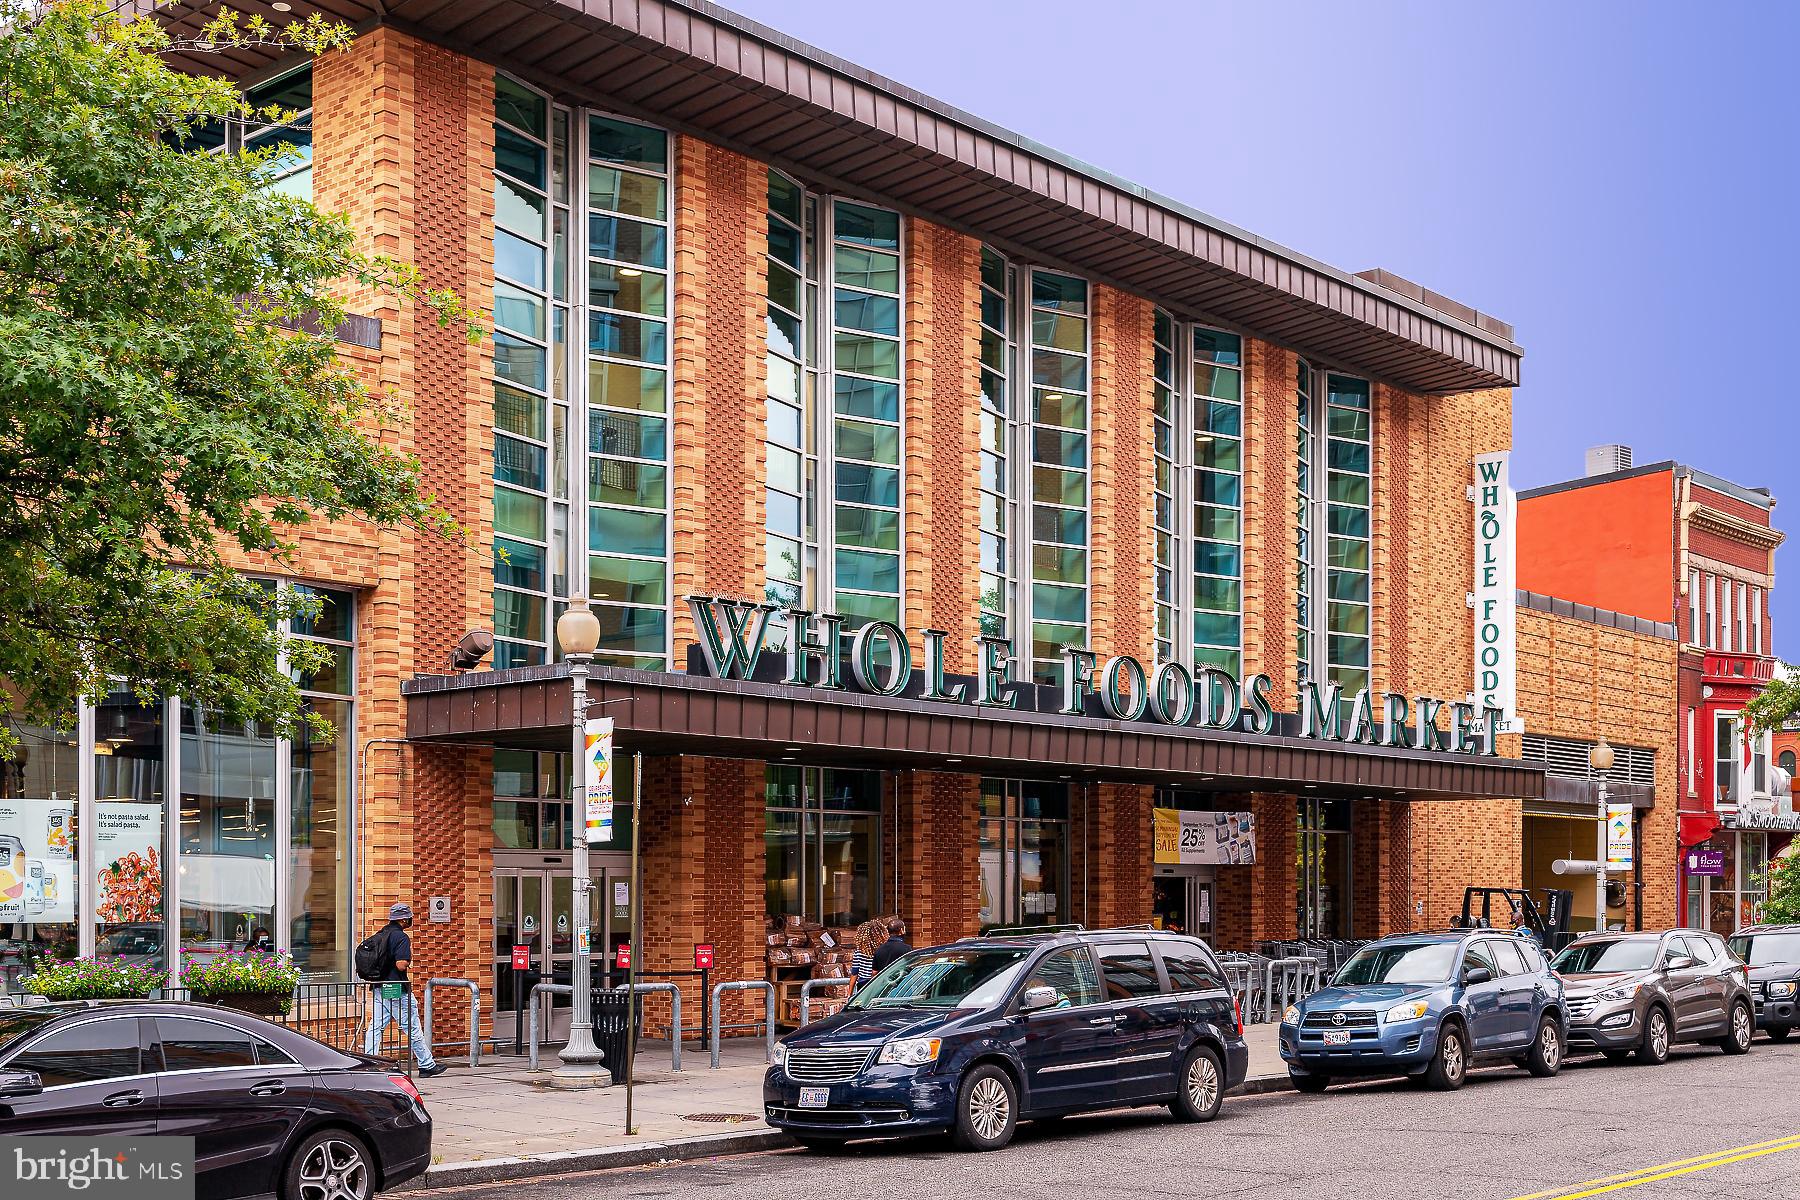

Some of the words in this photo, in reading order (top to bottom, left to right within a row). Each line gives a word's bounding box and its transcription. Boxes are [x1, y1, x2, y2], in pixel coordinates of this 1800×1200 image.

[1478, 461, 1502, 588] WHOLE
[1482, 599, 1499, 708] FOODS
[683, 595, 1018, 709] WHOLE
[1058, 648, 1273, 735] FOODS
[1297, 680, 1504, 757] MARKET
[1470, 720, 1511, 733] MAKET
[588, 792, 612, 804] PRIDE
[98, 812, 106, 820] It's
[118, 813, 133, 821] pasta
[98, 820, 106, 828] It's
[107, 820, 122, 828] salad
[123, 821, 140, 829] pasta.
[1156, 838, 1178, 852] SALE
[1700, 854, 1721, 865] flow
